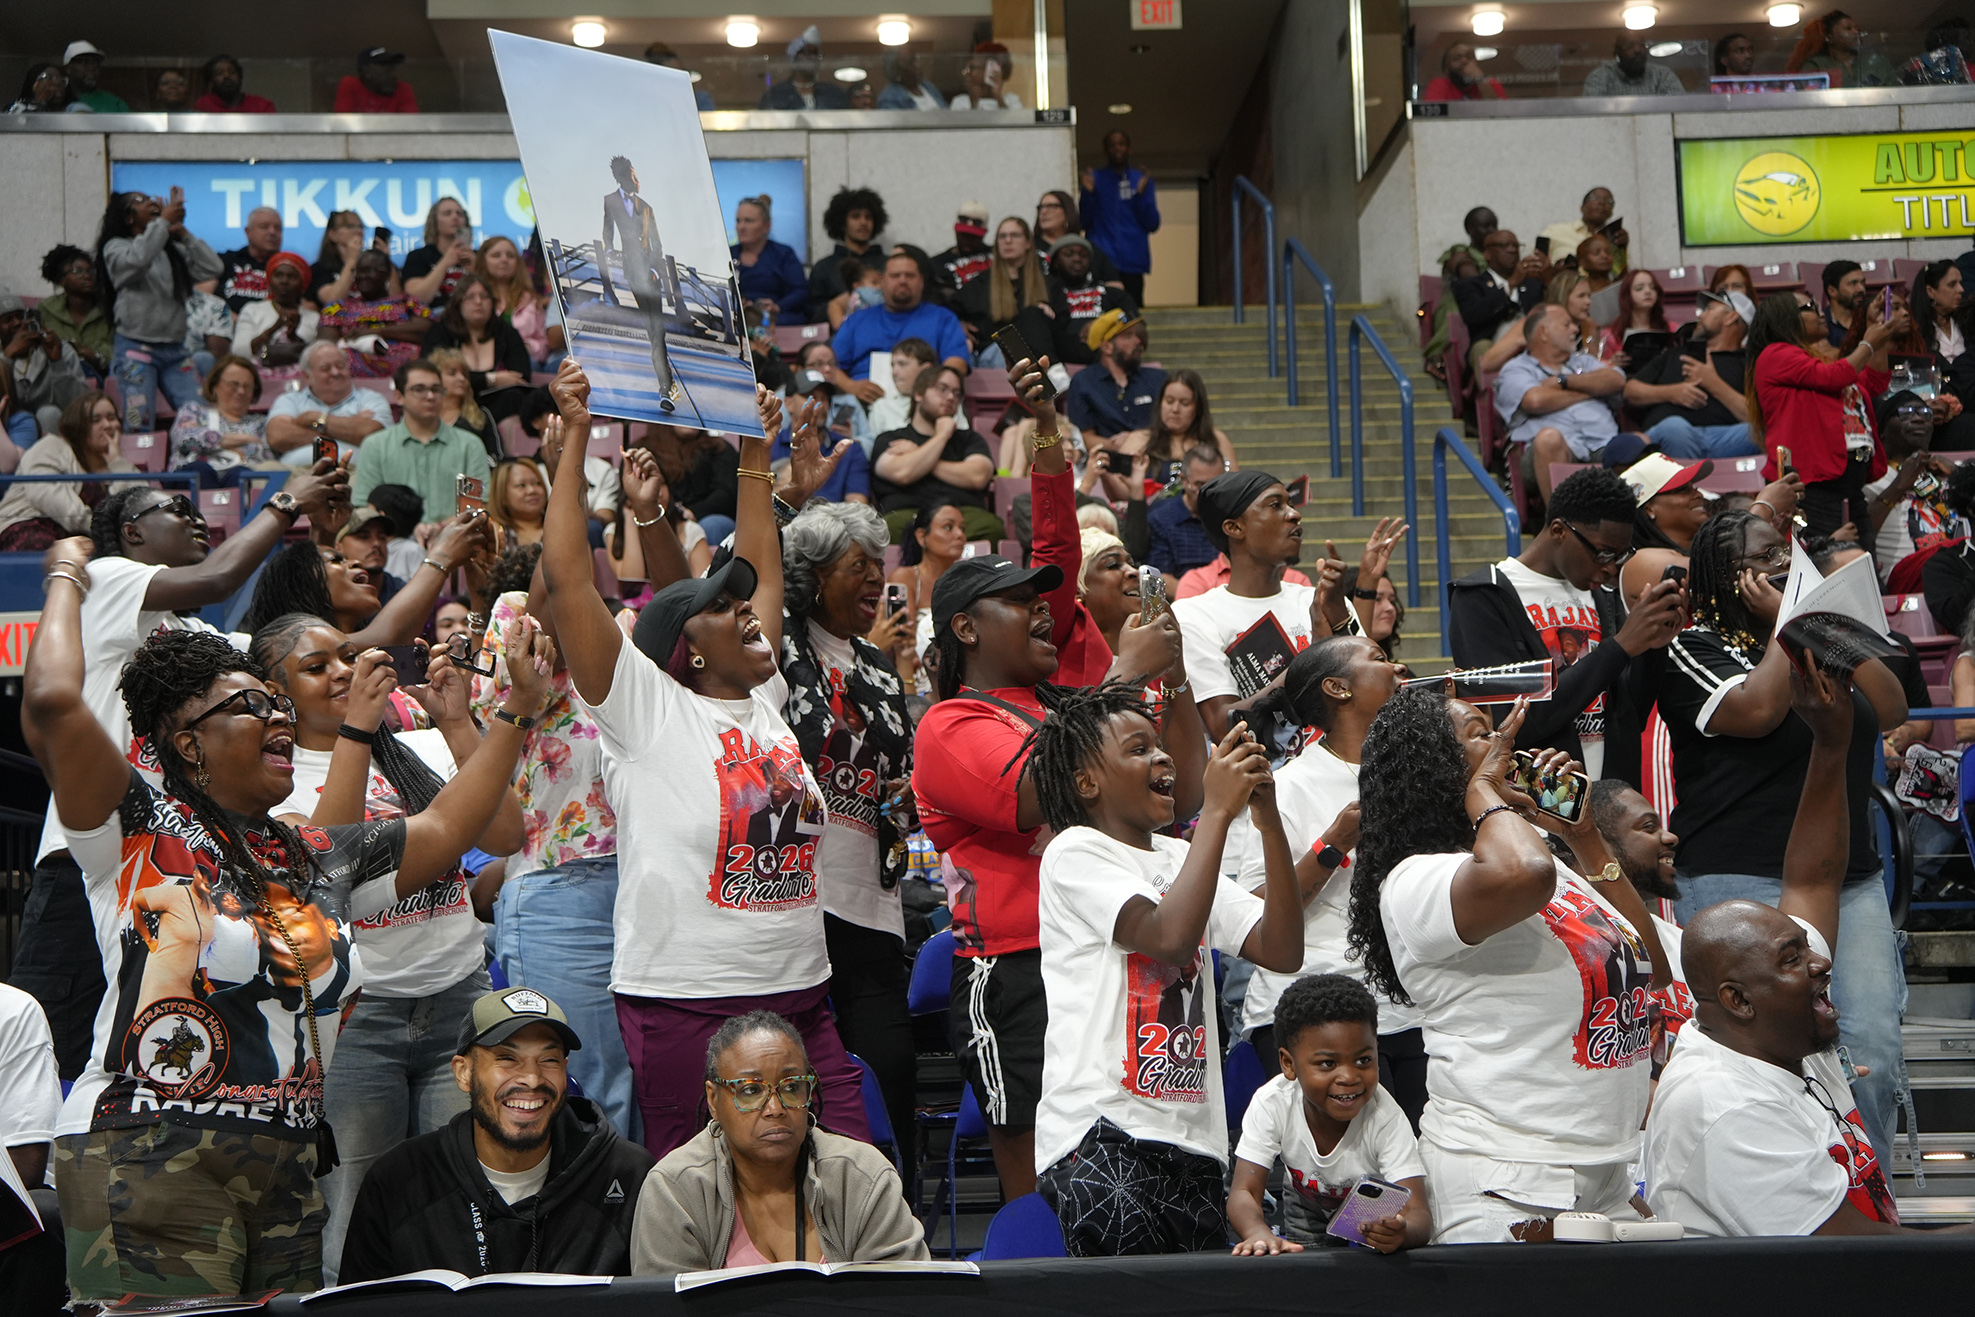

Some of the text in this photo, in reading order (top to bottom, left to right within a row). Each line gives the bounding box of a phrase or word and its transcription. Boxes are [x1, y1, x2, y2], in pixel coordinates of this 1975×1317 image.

[1140, 0, 1174, 24] EXIT
[211, 177, 482, 229] TIKKUN
[0, 621, 39, 667] XIT
[1246, 652, 1272, 687] ALMA MAT
[727, 843, 815, 880] 2026
[721, 868, 814, 907] Graduate
[748, 899, 786, 913] STRATFORD
[132, 1002, 225, 1051] STRATFORD HIGH
[1588, 983, 1650, 1033] 202
